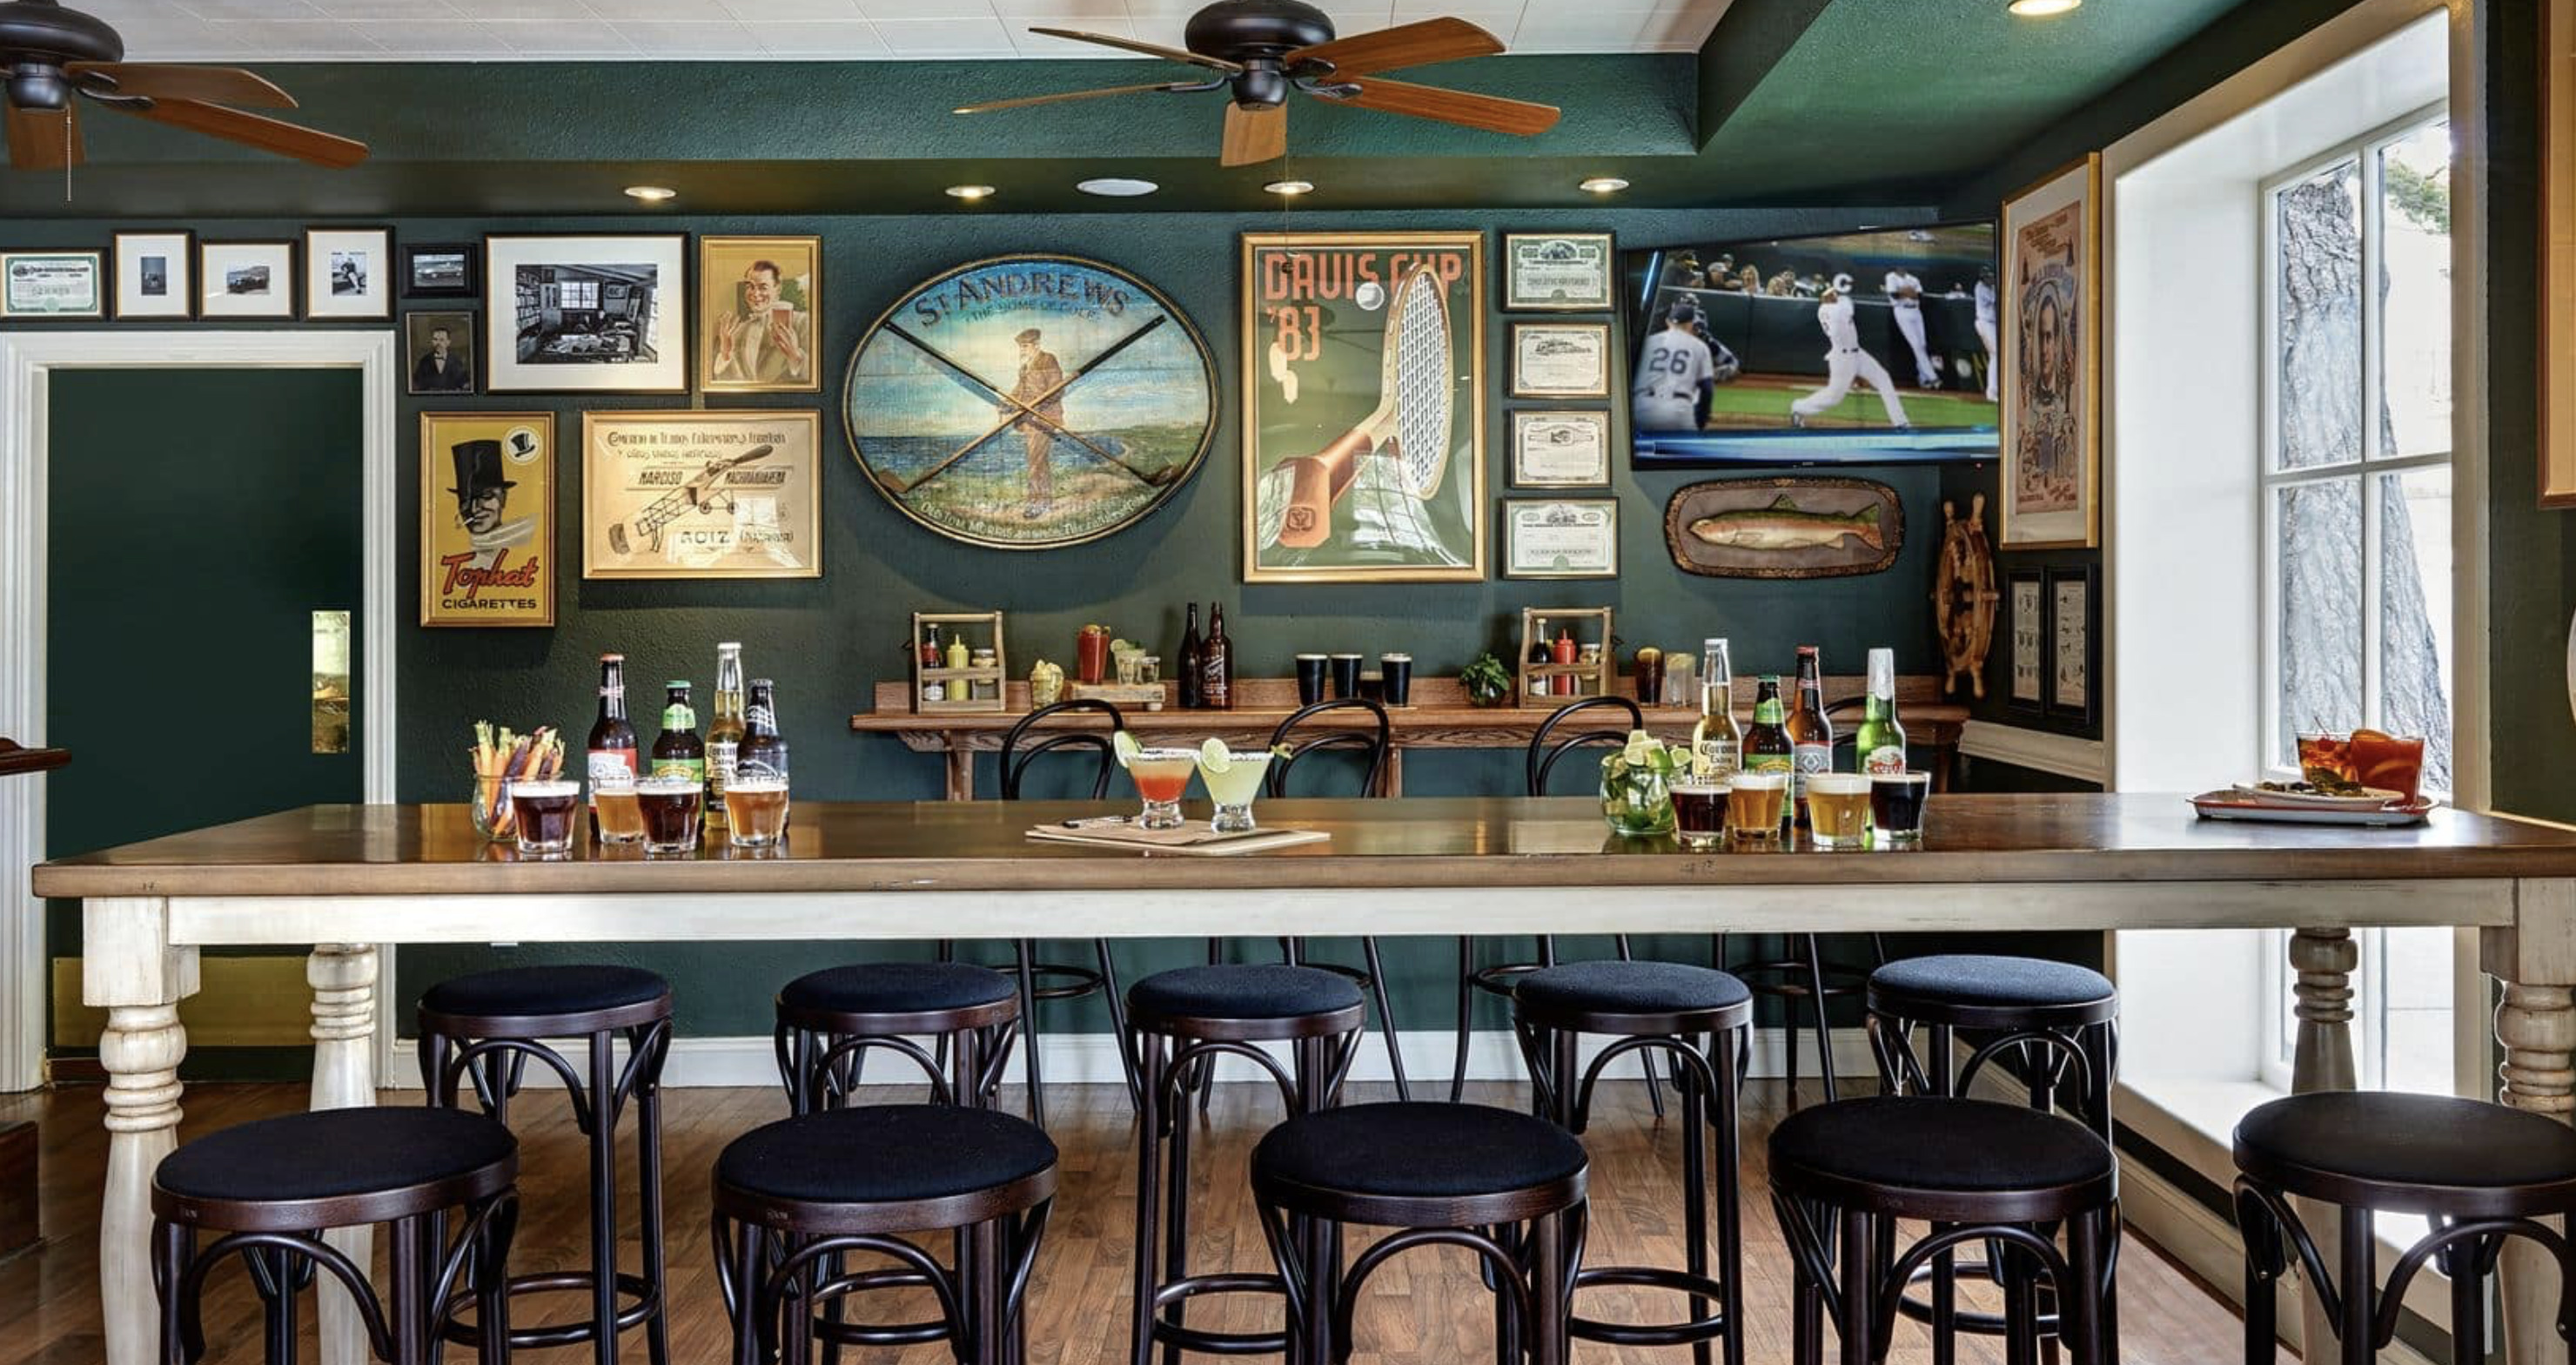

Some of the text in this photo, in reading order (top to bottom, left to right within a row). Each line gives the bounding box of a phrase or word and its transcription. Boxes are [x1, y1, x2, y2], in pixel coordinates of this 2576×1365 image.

[956, 272, 1130, 316] ANDREWS
[1390, 252, 1462, 300] CP
[1648, 347, 1691, 374] 26
[440, 548, 540, 600] Tophat
[442, 599, 537, 609] CIGARETTES
